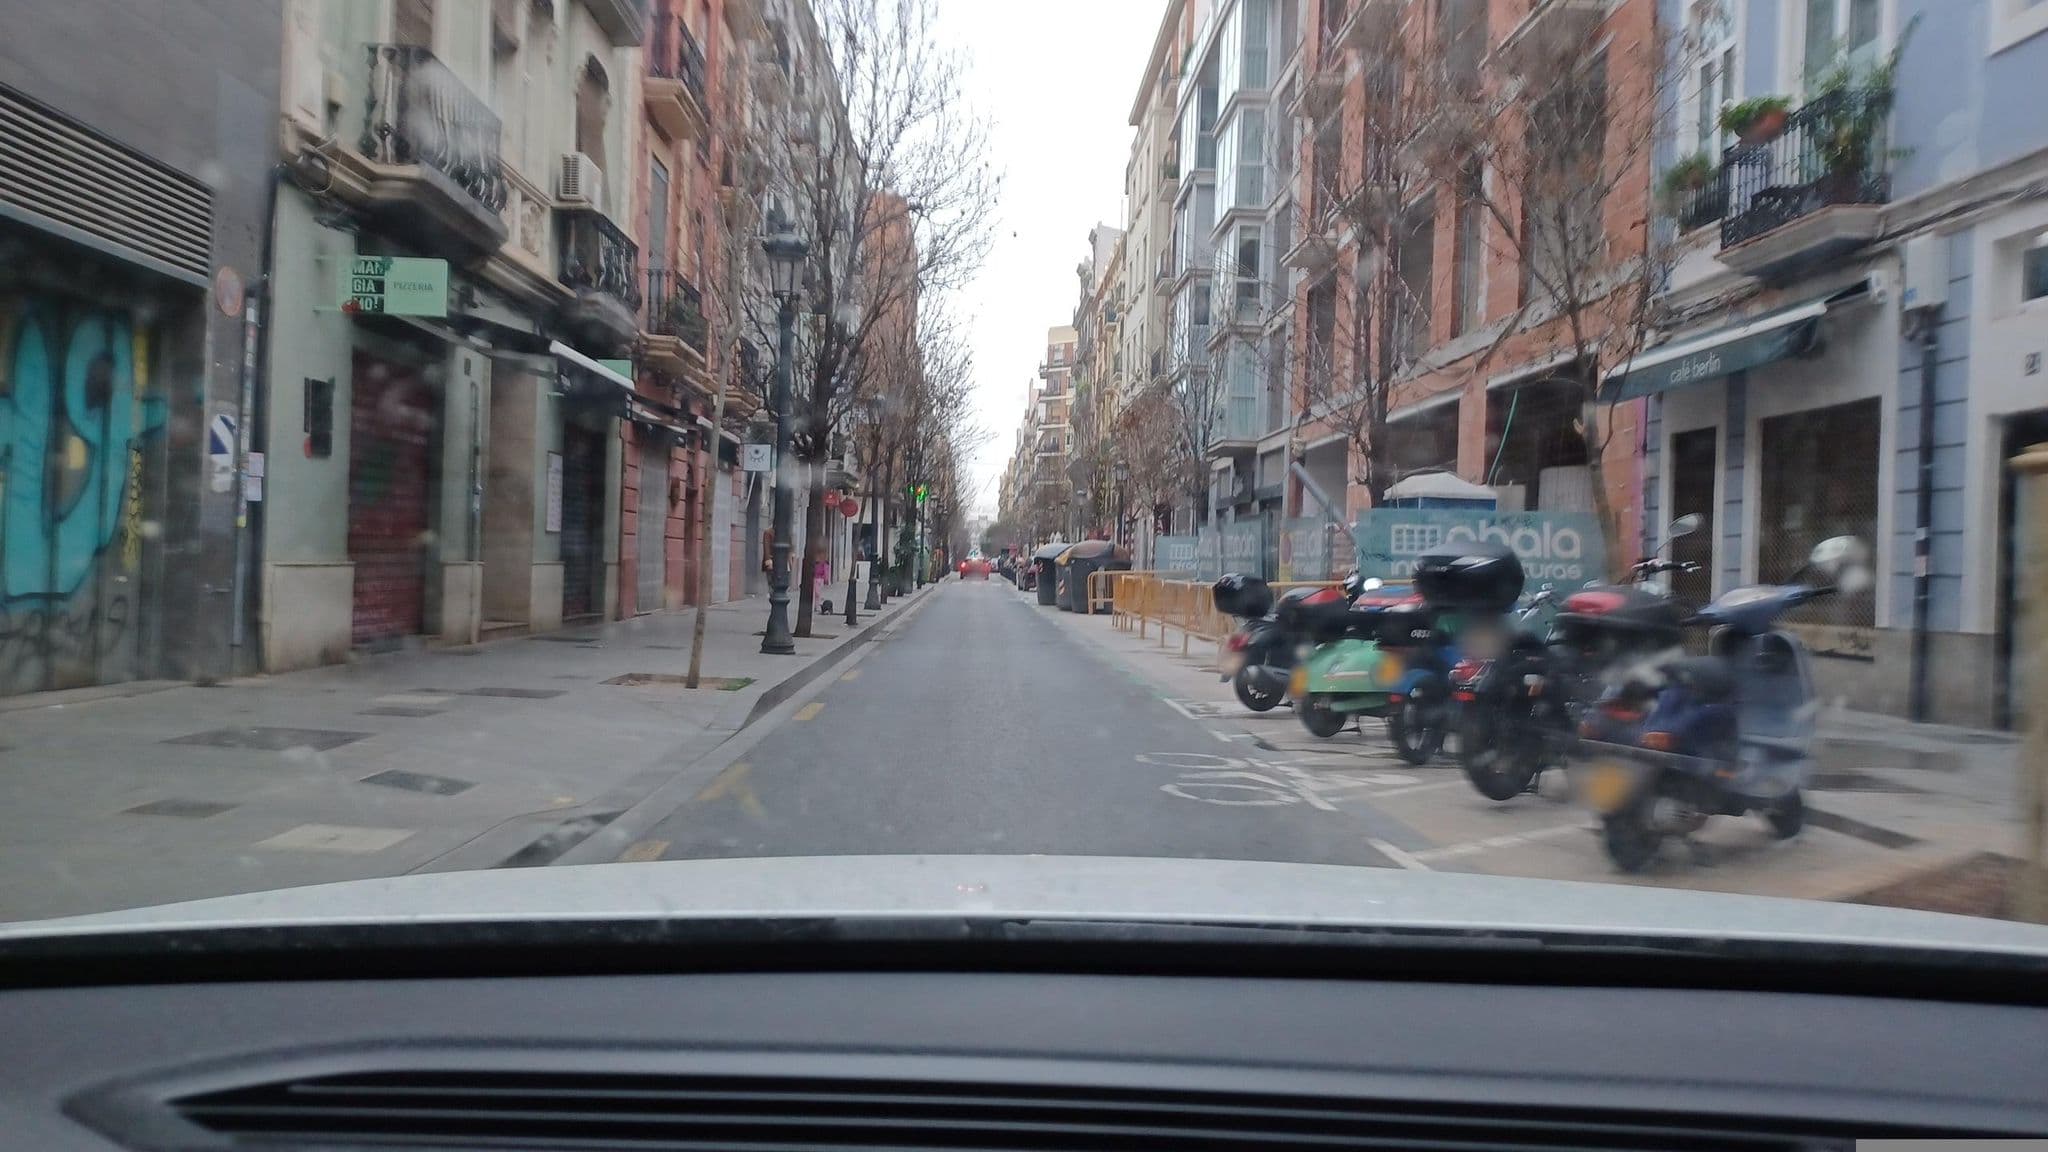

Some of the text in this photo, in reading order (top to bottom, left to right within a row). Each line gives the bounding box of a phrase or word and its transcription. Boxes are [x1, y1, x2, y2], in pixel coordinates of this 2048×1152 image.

[353, 279, 376, 293] GIA
[393, 281, 433, 291] PIZZERIA
[1693, 351, 1721, 378] berlin
